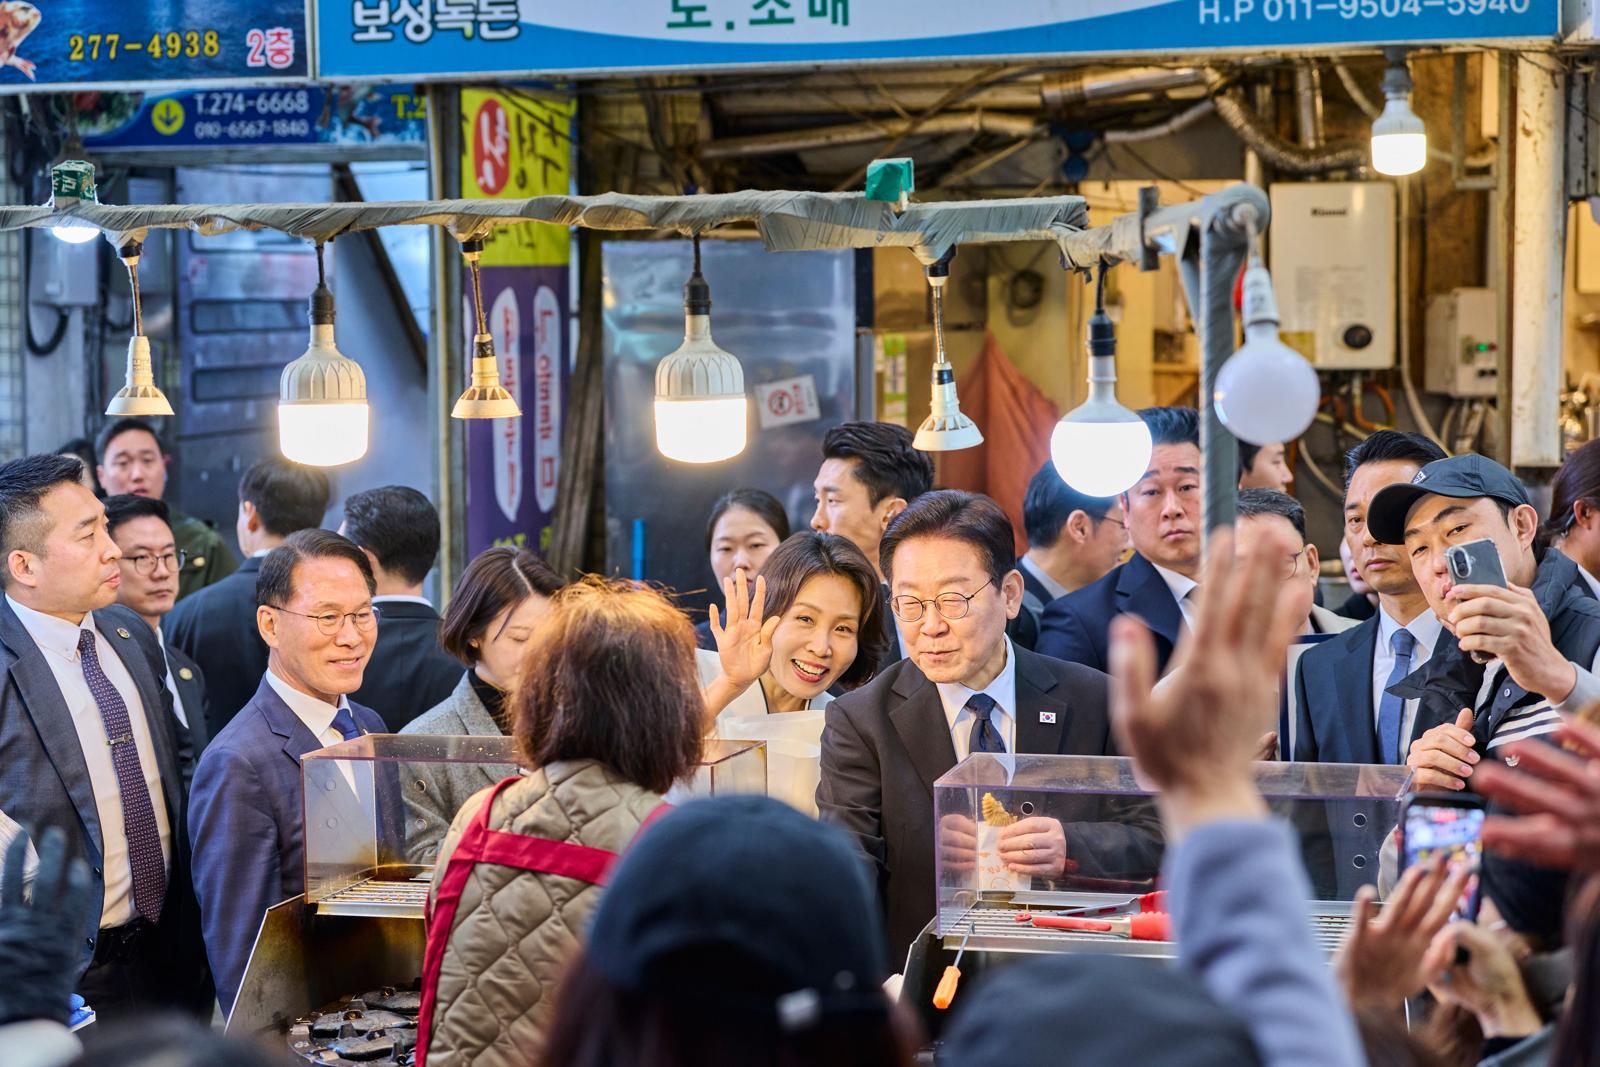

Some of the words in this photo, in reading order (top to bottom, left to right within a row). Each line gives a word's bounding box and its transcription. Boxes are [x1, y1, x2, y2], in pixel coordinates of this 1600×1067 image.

[1199, 0, 1254, 24] H.P
[69, 30, 220, 61] 277-4938
[246, 26, 295, 69] 2층
[194, 90, 309, 115] T.274-6668
